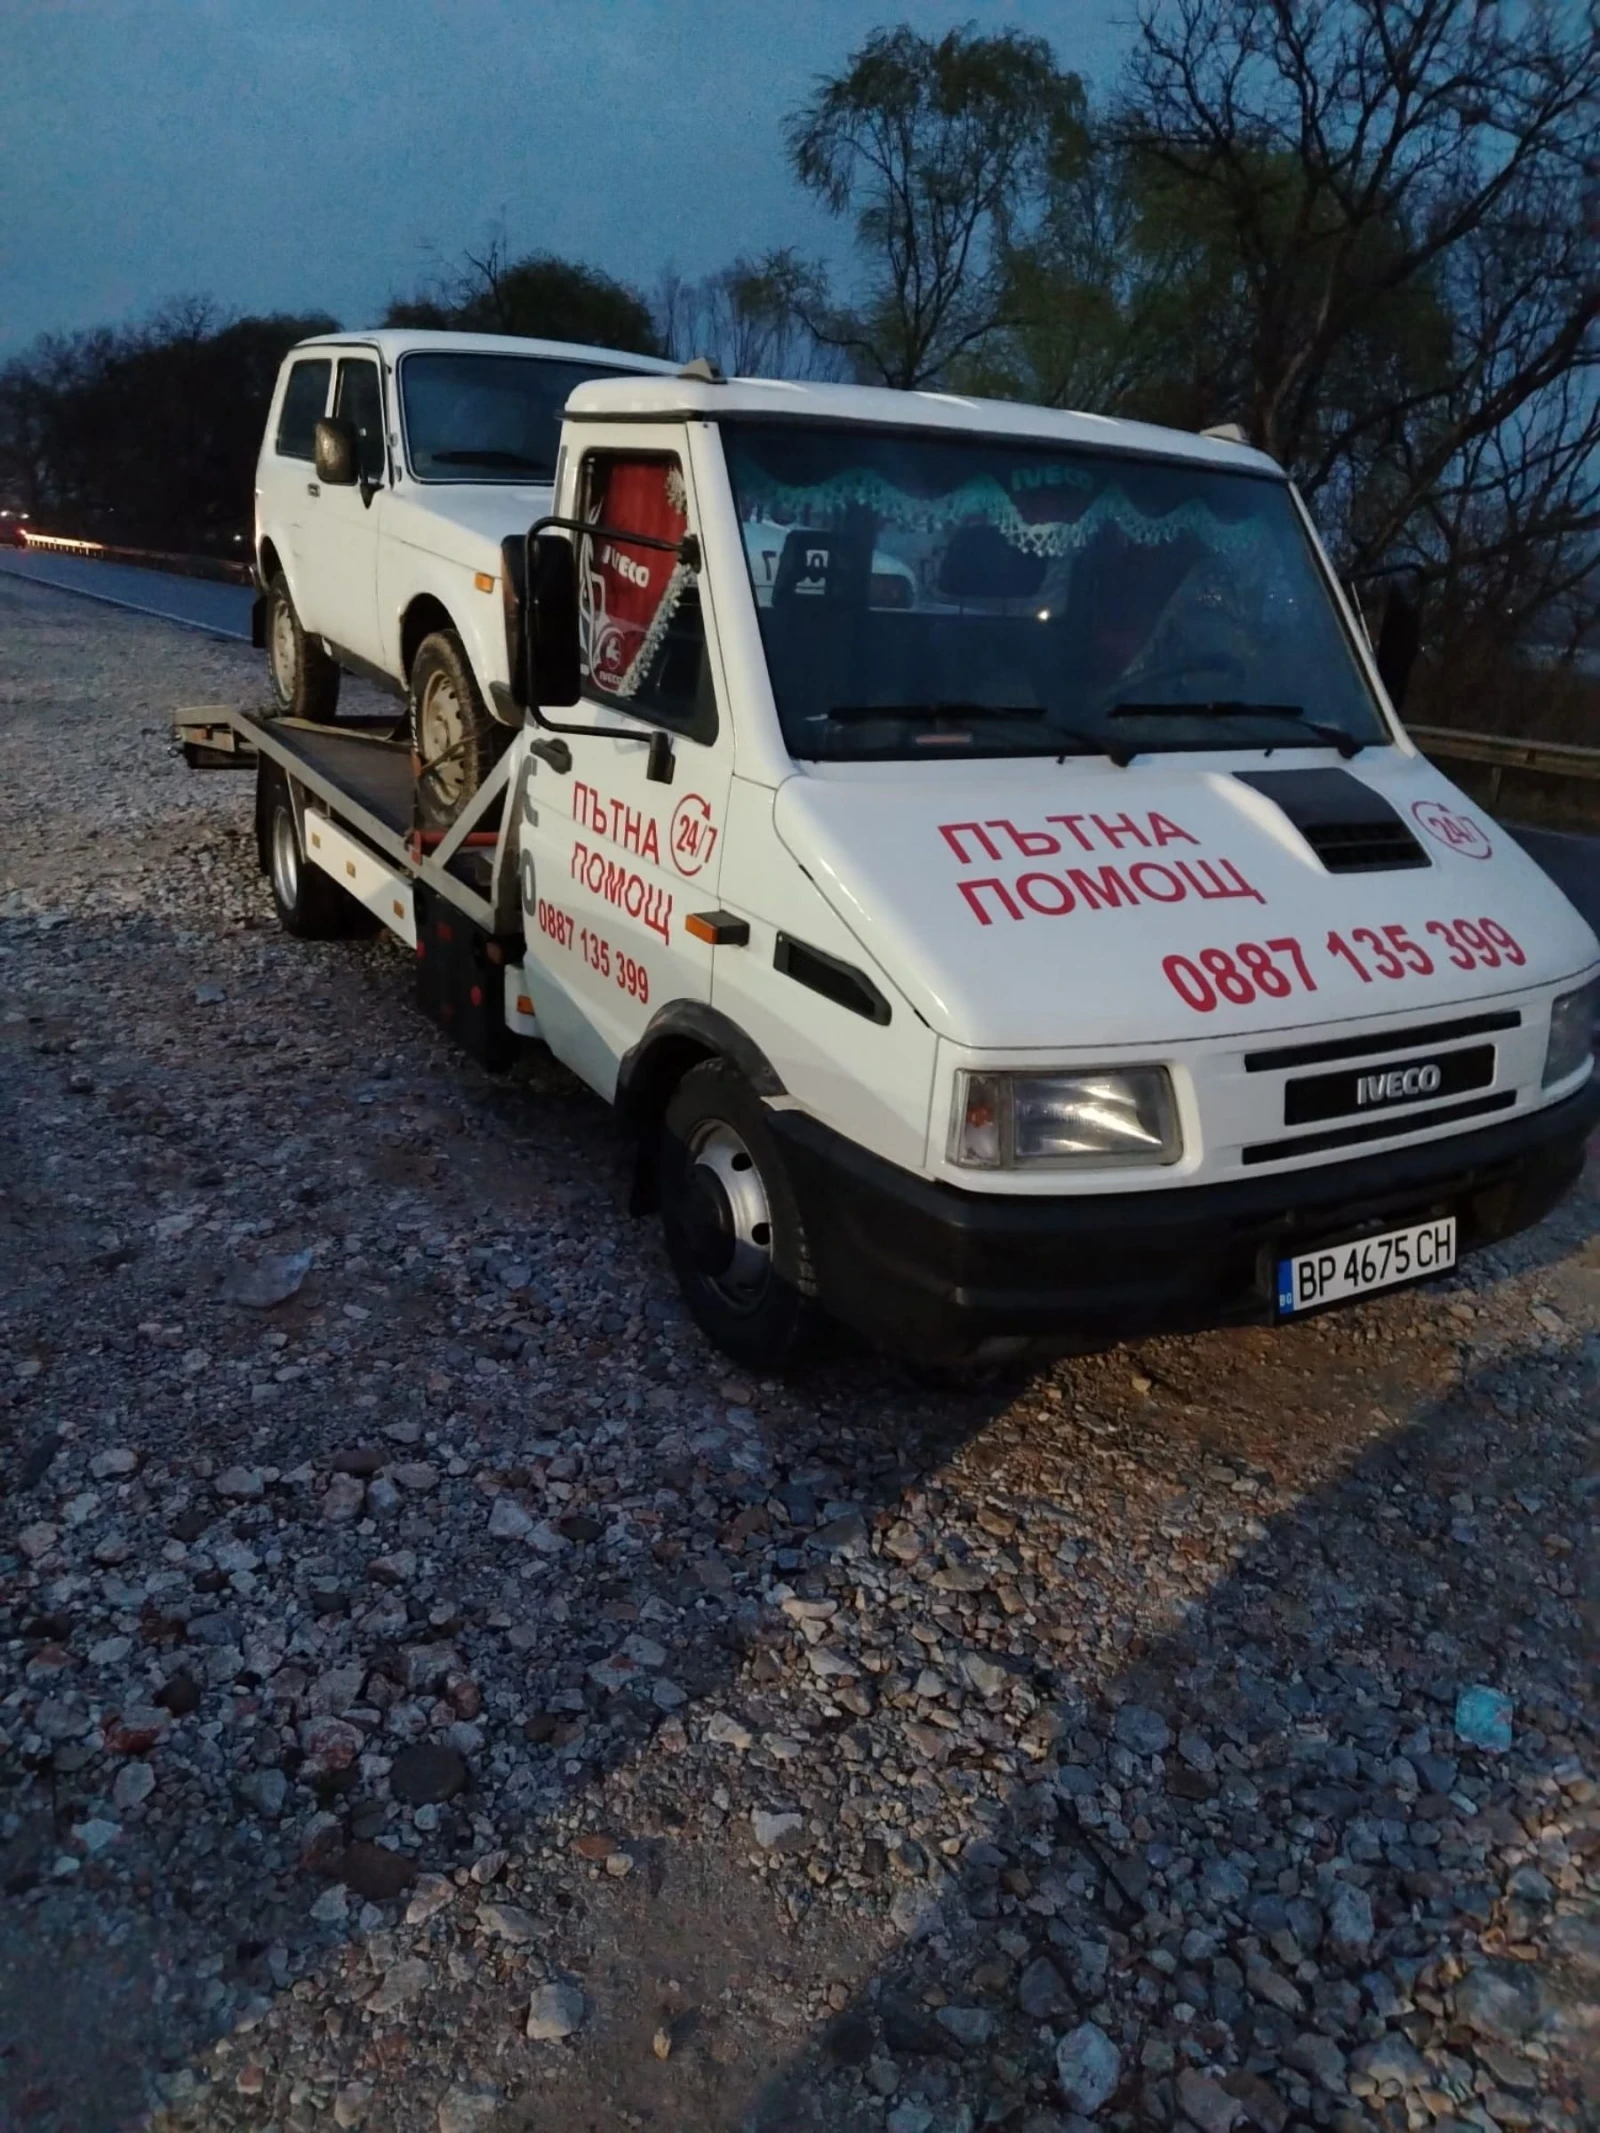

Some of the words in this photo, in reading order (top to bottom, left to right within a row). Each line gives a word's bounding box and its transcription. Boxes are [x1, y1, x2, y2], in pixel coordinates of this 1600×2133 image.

[602, 545, 649, 588] IVECO
[573, 781, 660, 865] ПЪТНА
[676, 814, 718, 864] 24/7
[937, 811, 1202, 864] ПЪТНА
[571, 841, 673, 946] ПОМОЩ
[956, 858, 1268, 926] ПОМОЩ
[538, 898, 574, 950] 0887
[581, 928, 610, 977] 135
[616, 951, 649, 1004] 399
[1162, 937, 1318, 1012] 0887
[1327, 924, 1434, 983] 135
[1425, 917, 1526, 970] 399
[1357, 1064, 1441, 1105] IVECO
[1299, 1255, 1336, 1302] BP
[1343, 1235, 1410, 1287] 4675
[1416, 1224, 1451, 1268] CH
